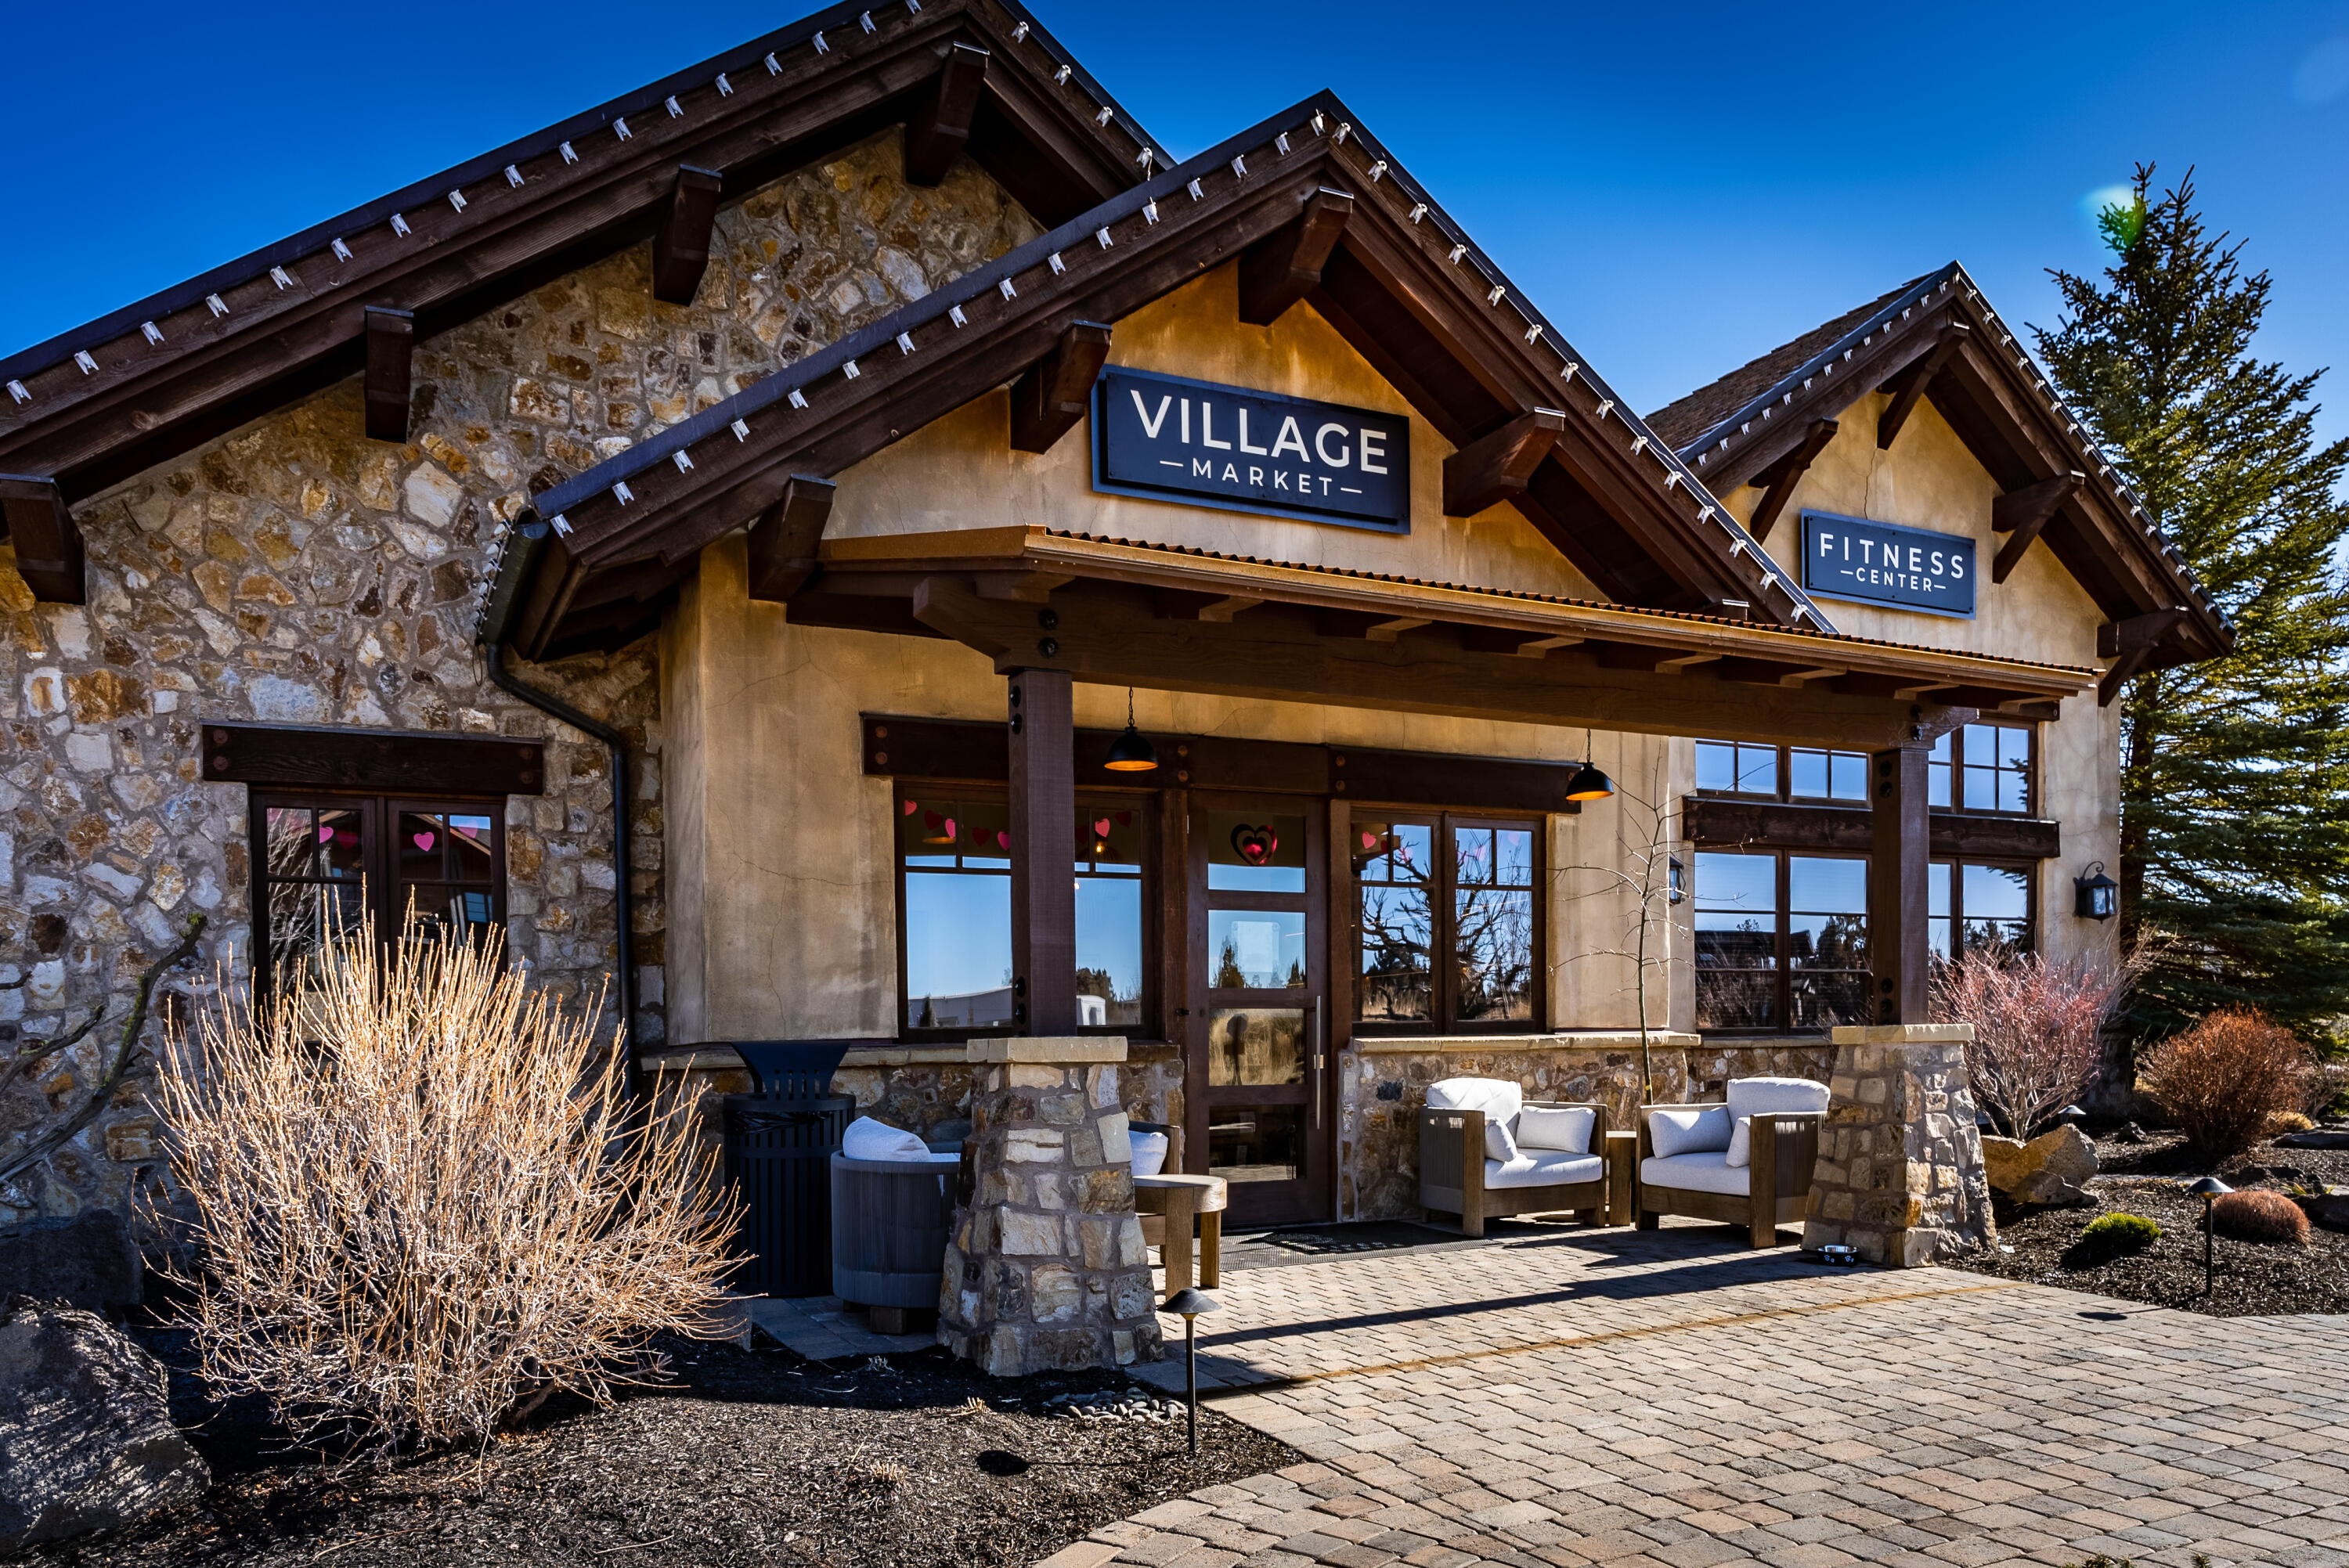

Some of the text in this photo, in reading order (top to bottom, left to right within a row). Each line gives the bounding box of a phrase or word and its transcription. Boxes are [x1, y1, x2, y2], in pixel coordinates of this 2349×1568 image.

[1130, 389, 1388, 475] VILLAGE
[1193, 457, 1333, 496] MARKET
[1820, 532, 1964, 579] FITNESS
[1856, 567, 1932, 593] CENTER
